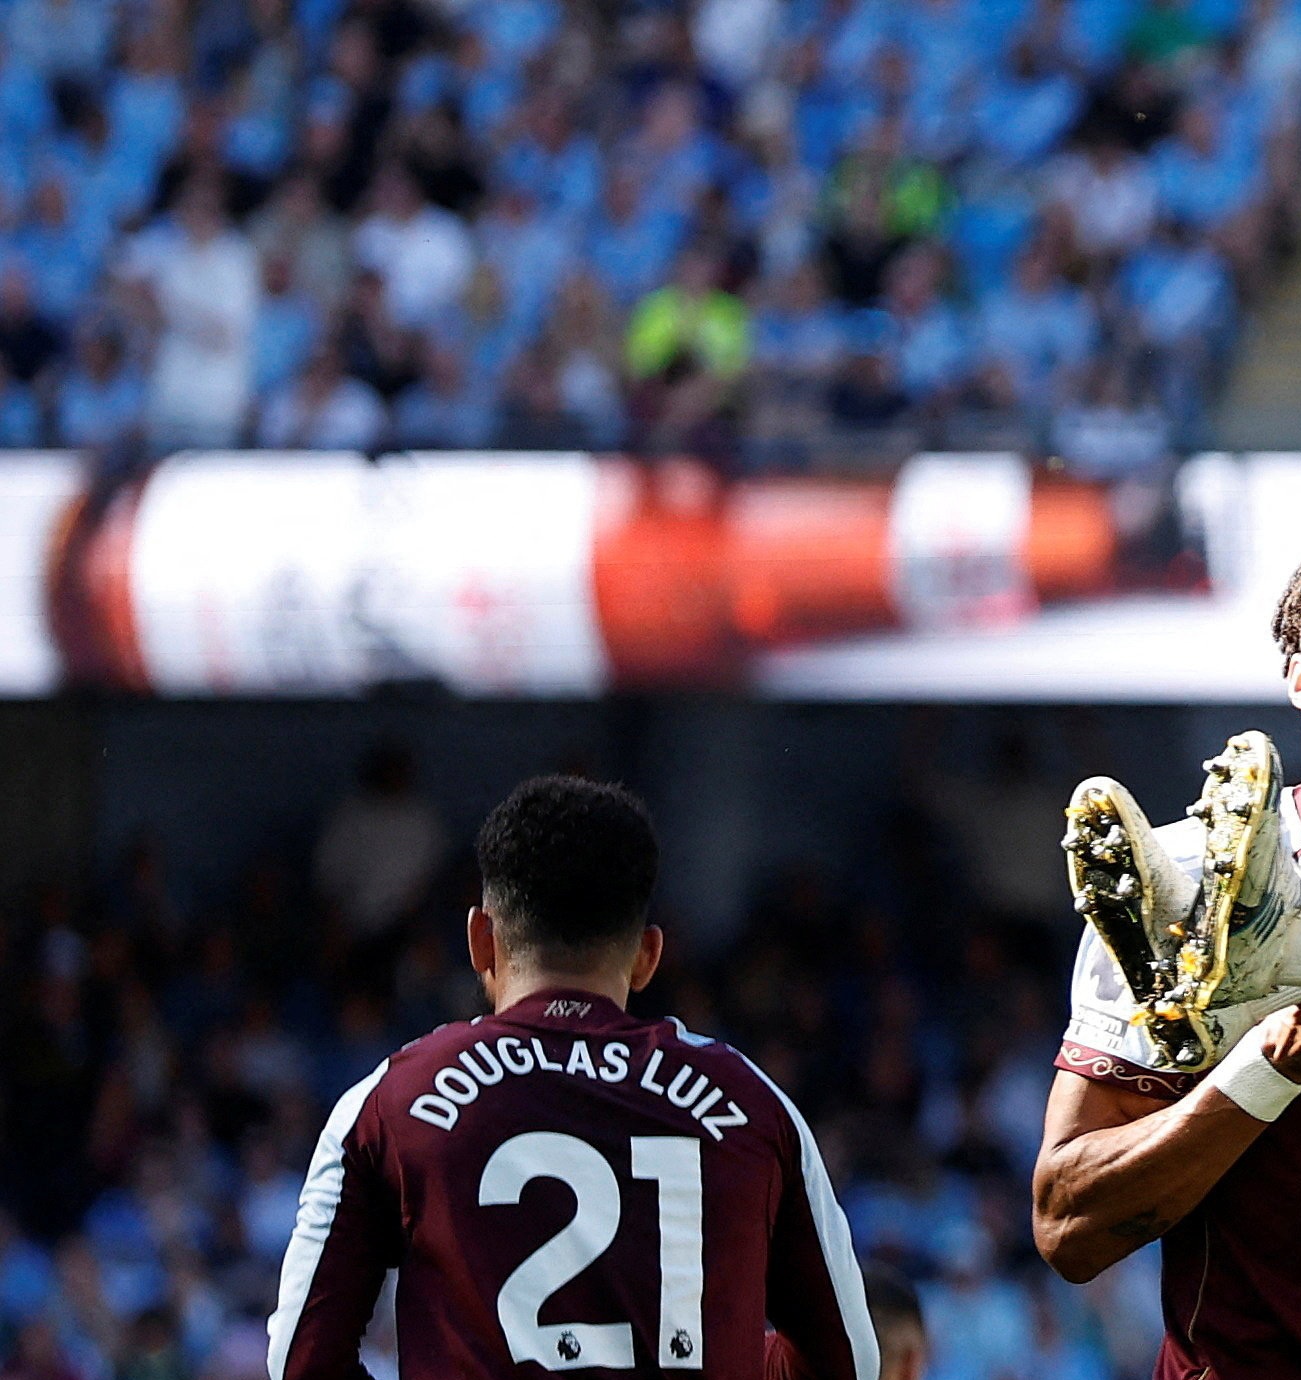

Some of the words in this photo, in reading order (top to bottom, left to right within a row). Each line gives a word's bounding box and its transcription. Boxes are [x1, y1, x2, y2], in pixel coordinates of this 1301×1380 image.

[409, 1036, 629, 1132] DOUGLAS
[640, 1048, 748, 1142] LUIZ
[479, 1131, 704, 1371] 21
